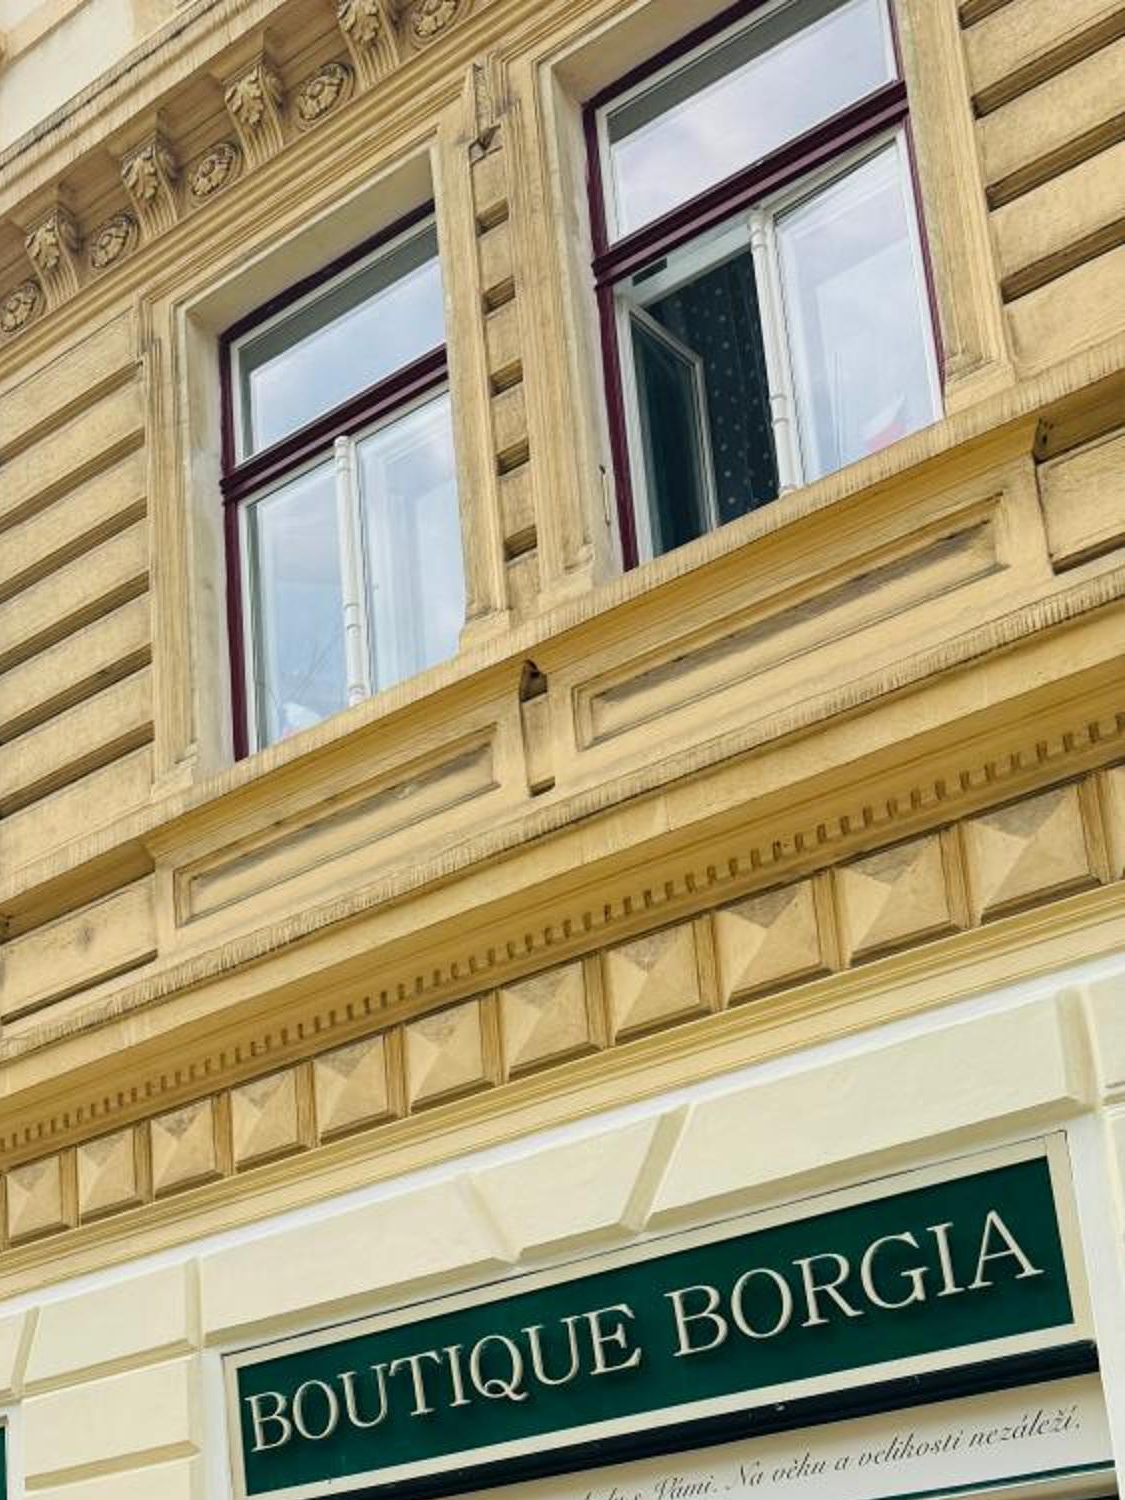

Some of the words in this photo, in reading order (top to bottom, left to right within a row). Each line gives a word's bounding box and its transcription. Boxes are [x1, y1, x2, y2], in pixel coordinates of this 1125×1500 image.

[246, 1303, 643, 1453] BOUTIQUE
[664, 1209, 1045, 1357] BORGIA
[725, 1460, 764, 1490] Na
[773, 1452, 827, 1481] věku
[834, 1453, 851, 1472] a
[859, 1432, 961, 1467] velikosti
[969, 1405, 1081, 1448] nezáleží.
